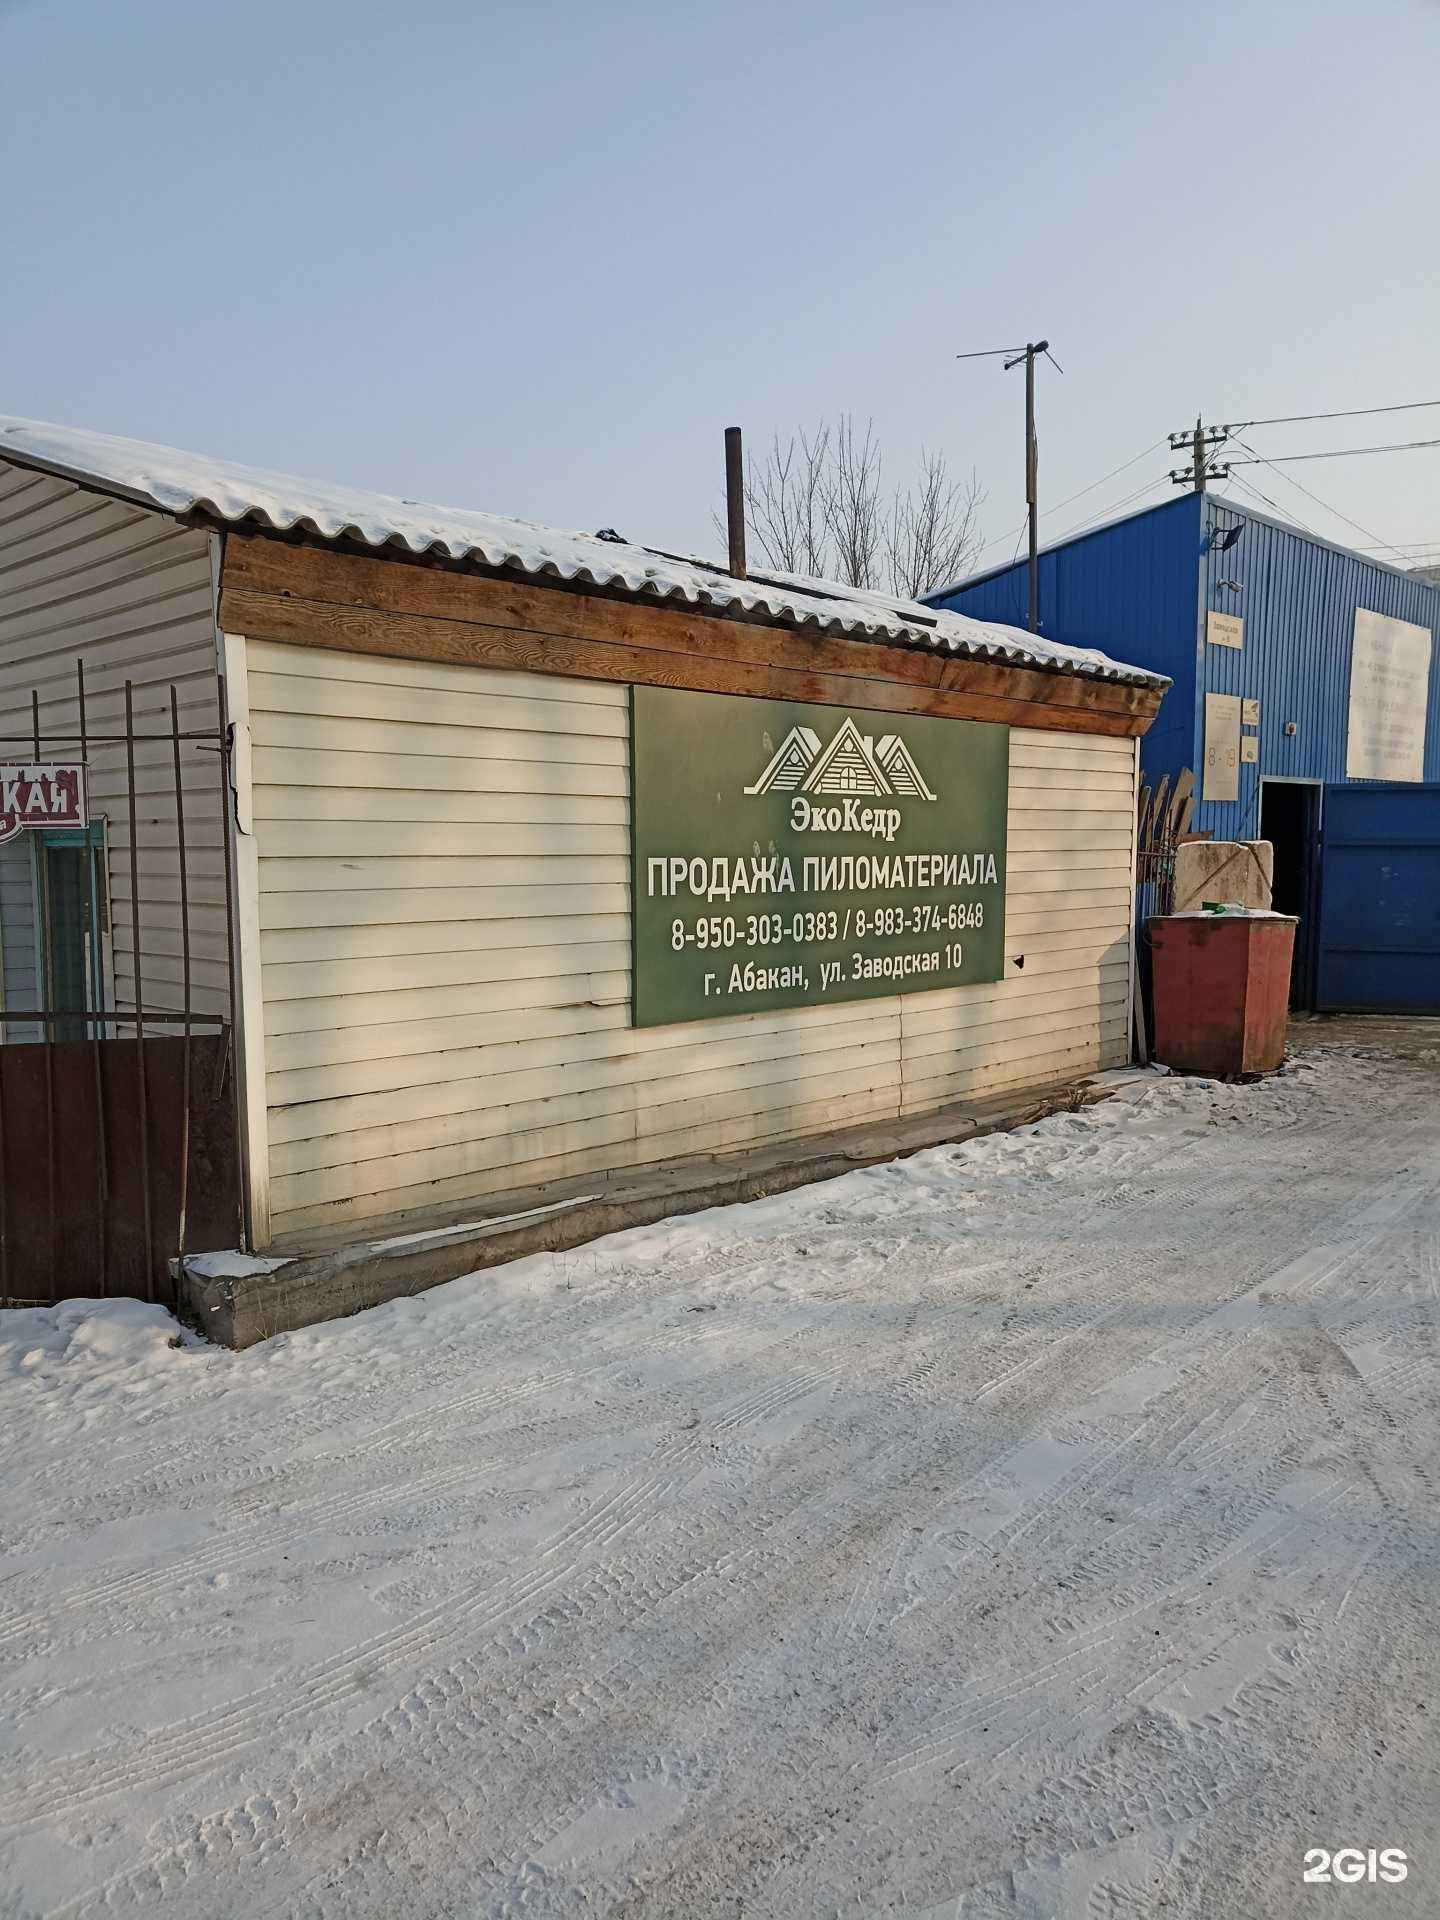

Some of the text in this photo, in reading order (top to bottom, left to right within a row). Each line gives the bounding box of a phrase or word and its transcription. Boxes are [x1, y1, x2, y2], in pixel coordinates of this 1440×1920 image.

[789, 797, 901, 841] ЭкоКедр
[647, 854, 998, 902] ПРОДАЖА ПИЛОМАТЕРИАЛА
[671, 902, 984, 951] 8-950-303-0383 / 8-983-374-6848
[704, 944, 963, 996] г. Абакан, ул. Заводская 10
